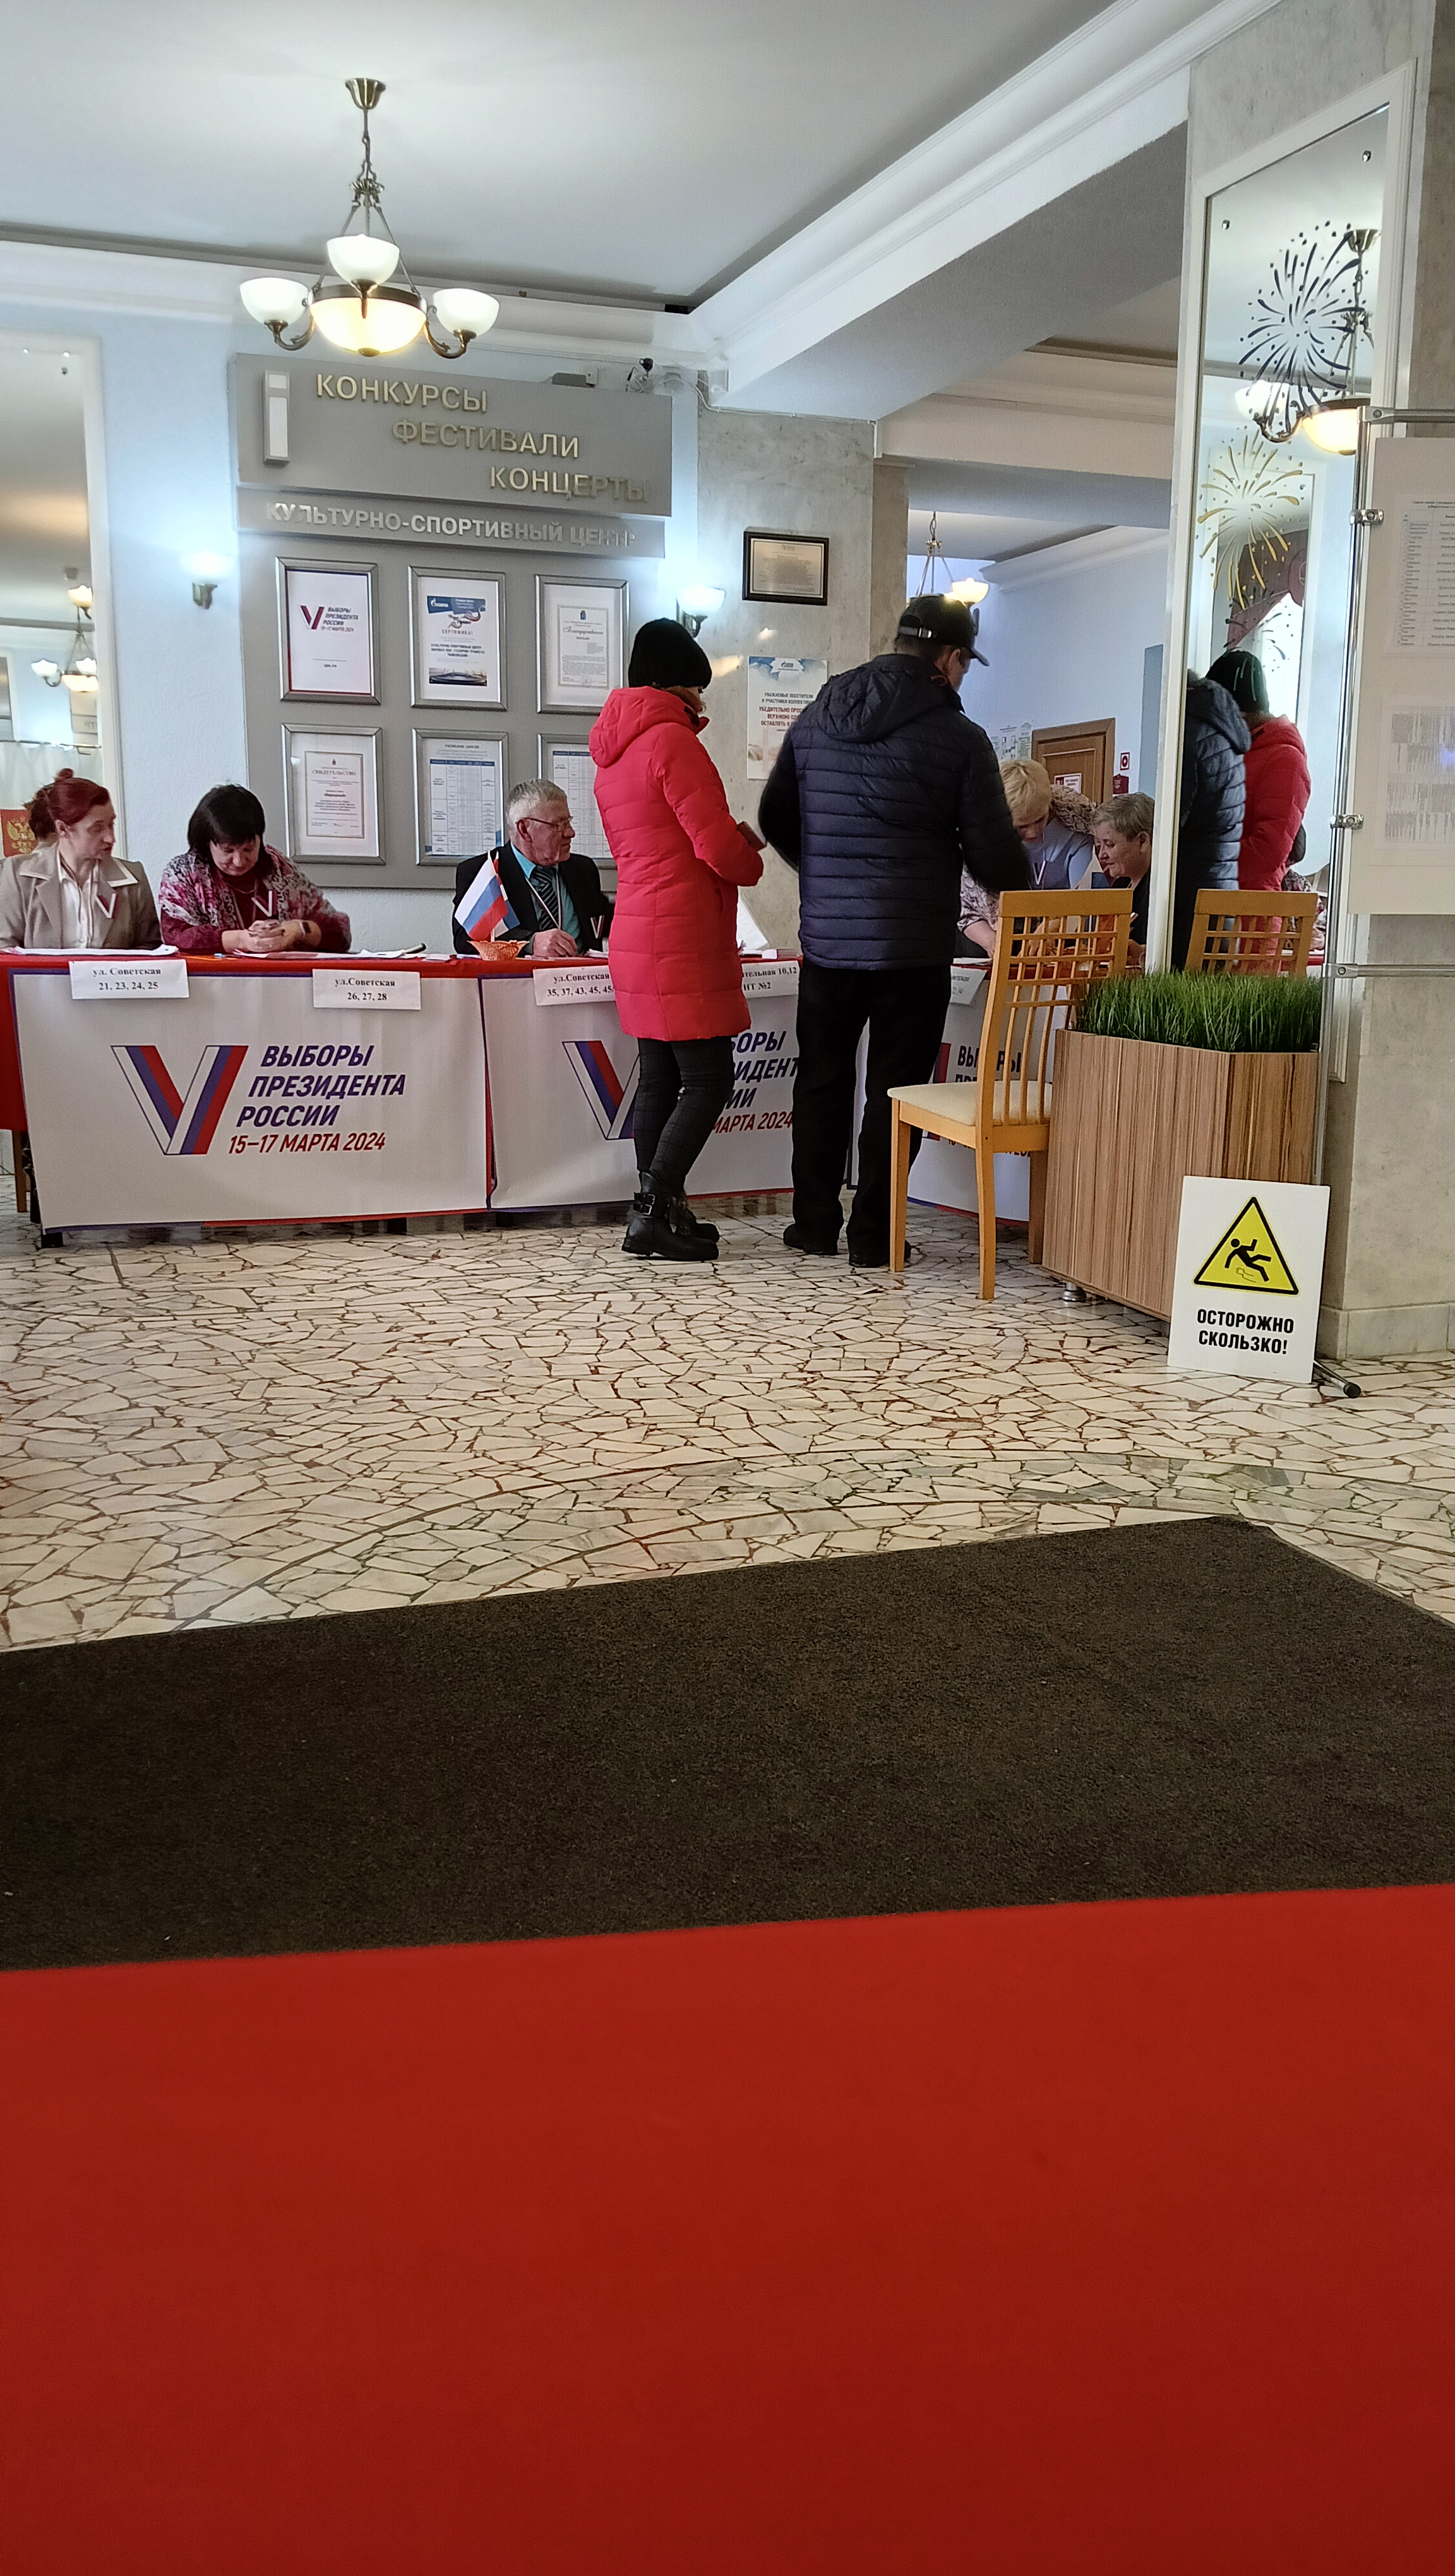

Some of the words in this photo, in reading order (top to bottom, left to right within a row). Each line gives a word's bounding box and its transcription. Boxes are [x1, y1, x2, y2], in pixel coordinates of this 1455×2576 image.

[316, 373, 488, 413] КОНКУРСЫ
[392, 419, 580, 458] ФЕСТИВАЛИ
[490, 466, 648, 503] КОНЦЕРТЫ
[266, 503, 563, 542] КУЛЬТУРНО-СПОРТИВНЫЙ
[570, 526, 636, 547] ЦЕНТР
[109, 967, 161, 975] Советская
[335, 977, 395, 987] ул.Советская
[554, 974, 610, 984] ул.Советская
[742, 970, 776, 978] тельная
[778, 967, 798, 975] 10,12
[99, 982, 112, 991] 21,
[115, 982, 129, 990] 23,
[132, 982, 145, 990] 24,
[148, 981, 159, 989] 25
[347, 992, 360, 1001] 26,
[362, 993, 375, 1001] 27,
[377, 993, 387, 1001] 28
[547, 989, 560, 997] 35,
[561, 988, 573, 996] 37,
[575, 987, 587, 995] 43,
[589, 986, 601, 994] 45,
[758, 982, 772, 990] №2
[731, 1031, 787, 1053] ОРЫ
[260, 1045, 375, 1068] ВЫБОРЫ
[734, 1057, 799, 1083] ИДЕНТ
[248, 1073, 407, 1100] ПРЕЗИДЕНТА
[236, 1105, 341, 1128] РОССИИ
[757, 1111, 793, 1130] 2024
[279, 1133, 340, 1153] МАРТА
[342, 1132, 386, 1152] 2024
[1197, 1309, 1294, 1333] ОСТОРОЖНО
[1199, 1330, 1288, 1354] СКОЛЬЗКО!
